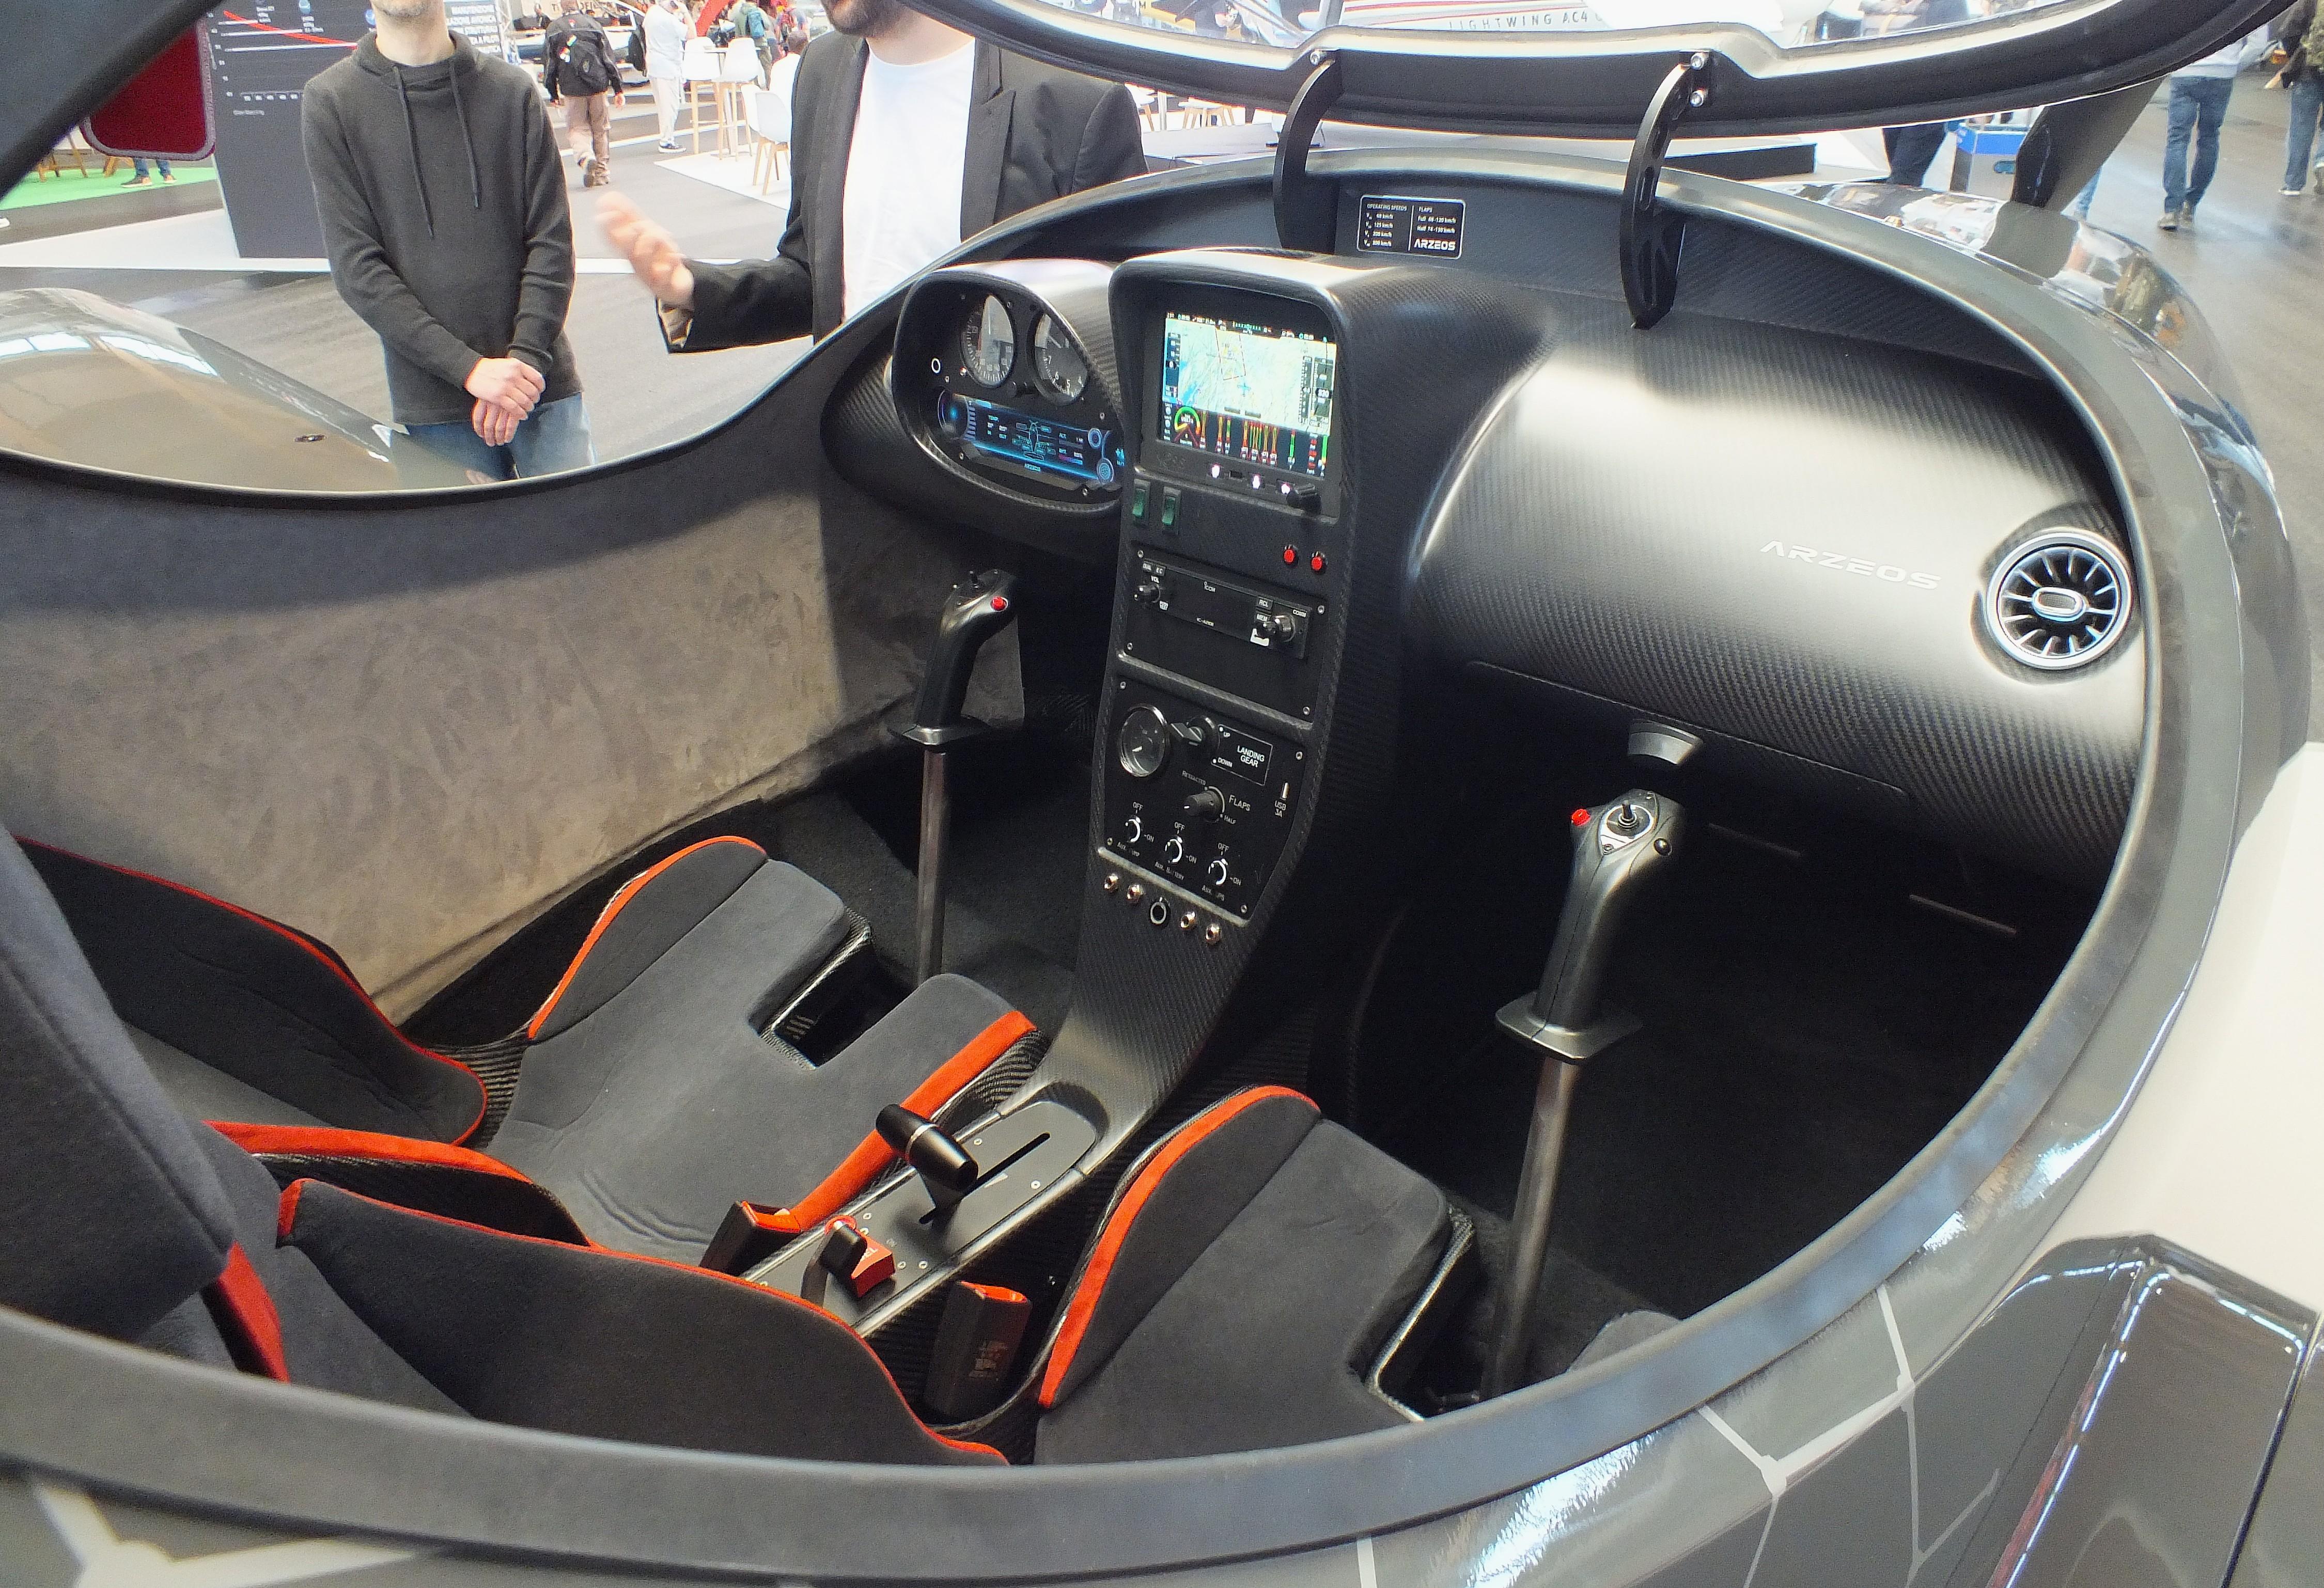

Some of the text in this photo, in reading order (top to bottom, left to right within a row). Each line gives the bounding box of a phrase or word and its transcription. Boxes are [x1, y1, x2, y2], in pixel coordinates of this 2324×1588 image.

[1413, 238, 1456, 251] ARZEOS
[1048, 355, 1052, 365] 7
[1055, 371, 1059, 380] 6
[1759, 539, 1942, 590] ARZEOS
[1151, 575, 1160, 584] VOL
[1259, 599, 1269, 607] RCL
[1237, 745, 1265, 762] LANDING
[1218, 757, 1233, 767] DOWN
[1240, 755, 1258, 768] GEAR
[1133, 801, 1143, 811] OFF
[1274, 800, 1286, 811] USB
[1174, 821, 1185, 831] OFF
[1218, 842, 1229, 852] OFF
